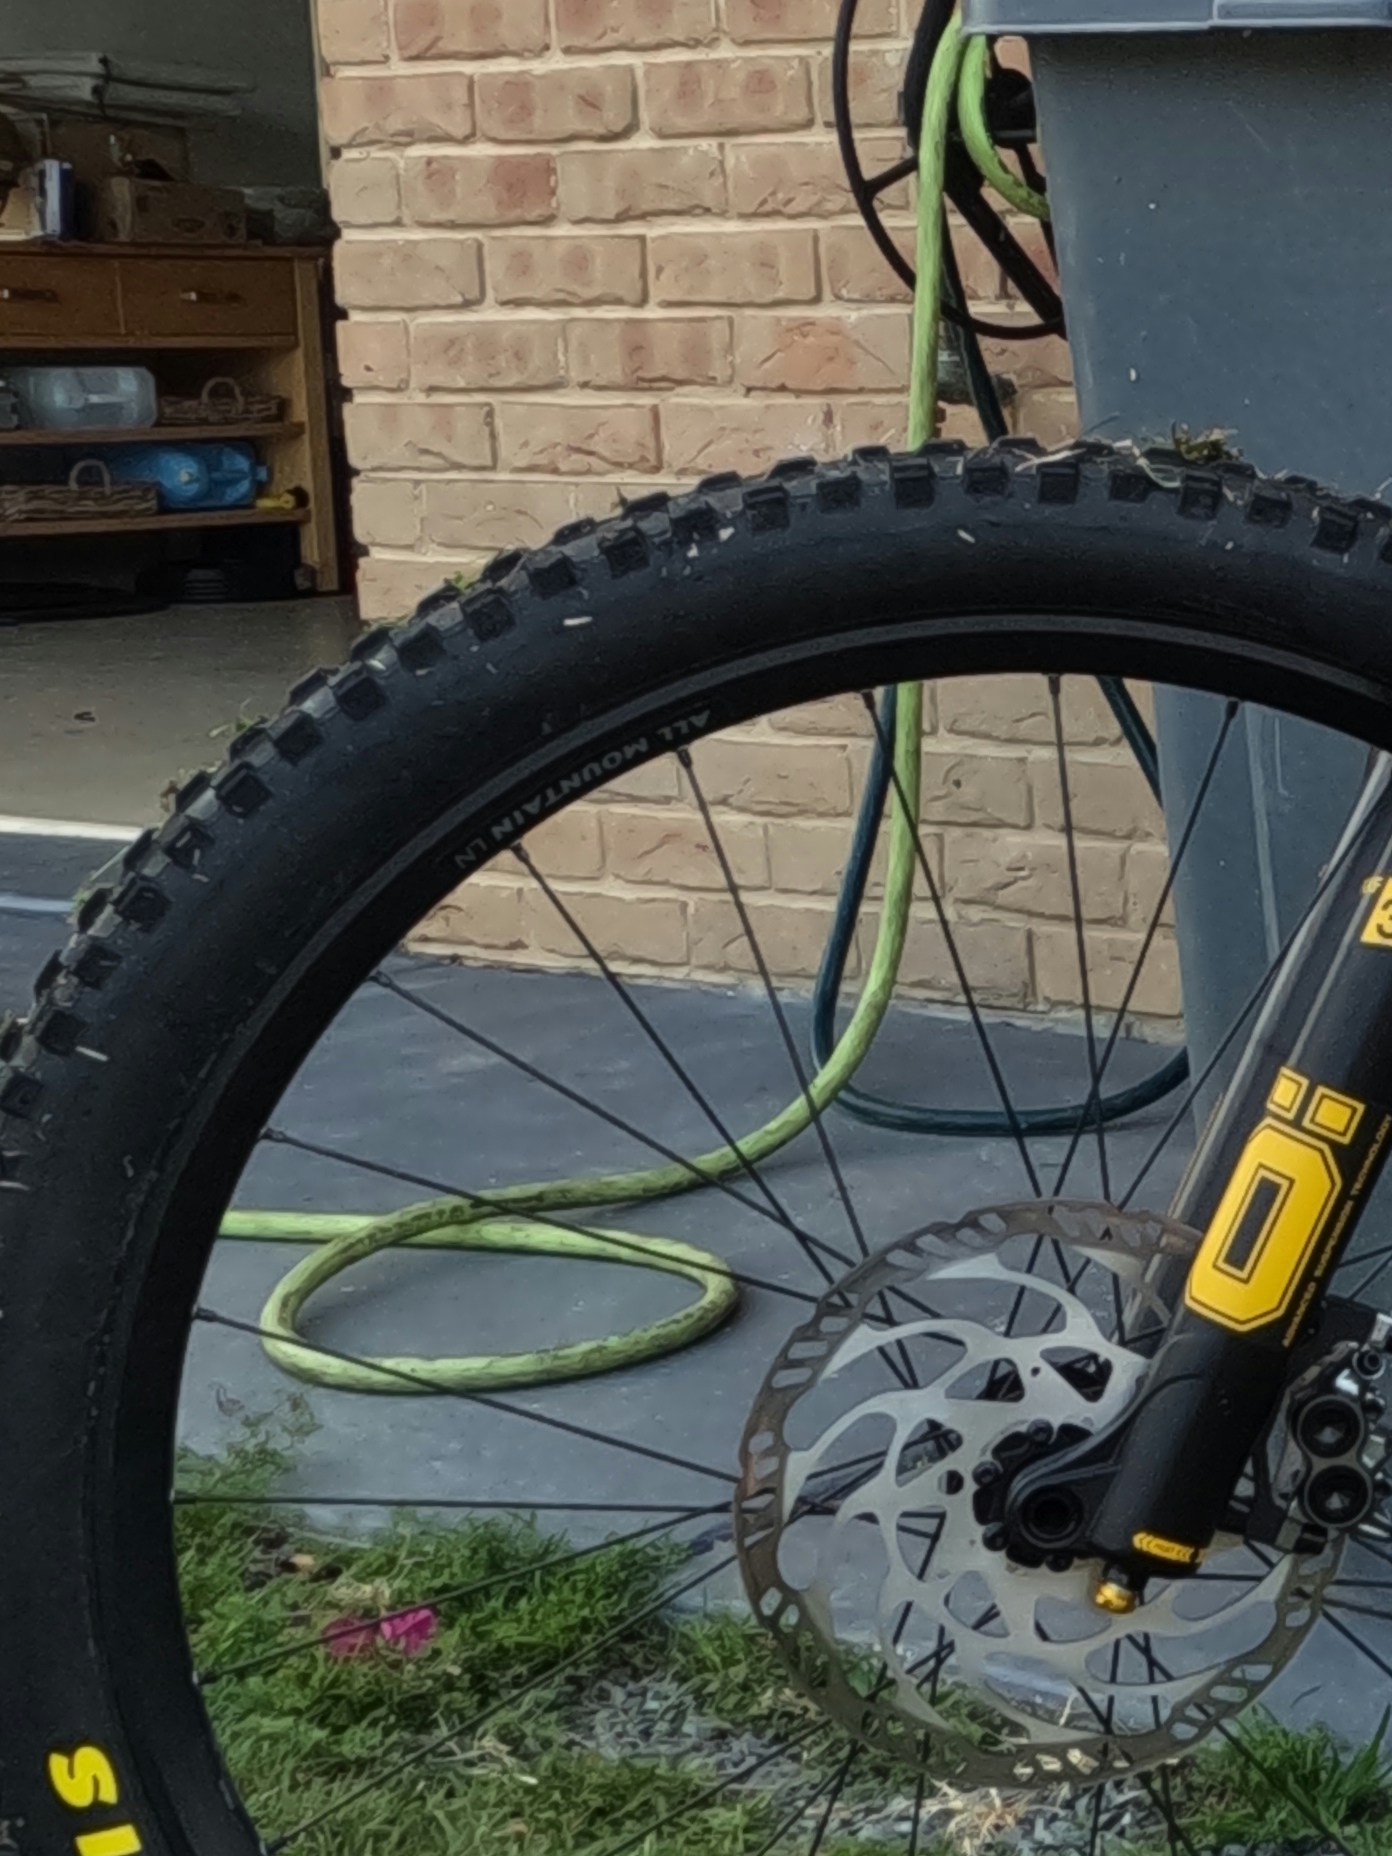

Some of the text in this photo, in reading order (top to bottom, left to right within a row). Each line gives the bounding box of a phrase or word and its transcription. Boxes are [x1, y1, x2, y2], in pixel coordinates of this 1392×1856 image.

[453, 709, 711, 870] ALL MOUNTAIN LN
[1350, 1112, 1392, 1196] TECHNOLOGY
